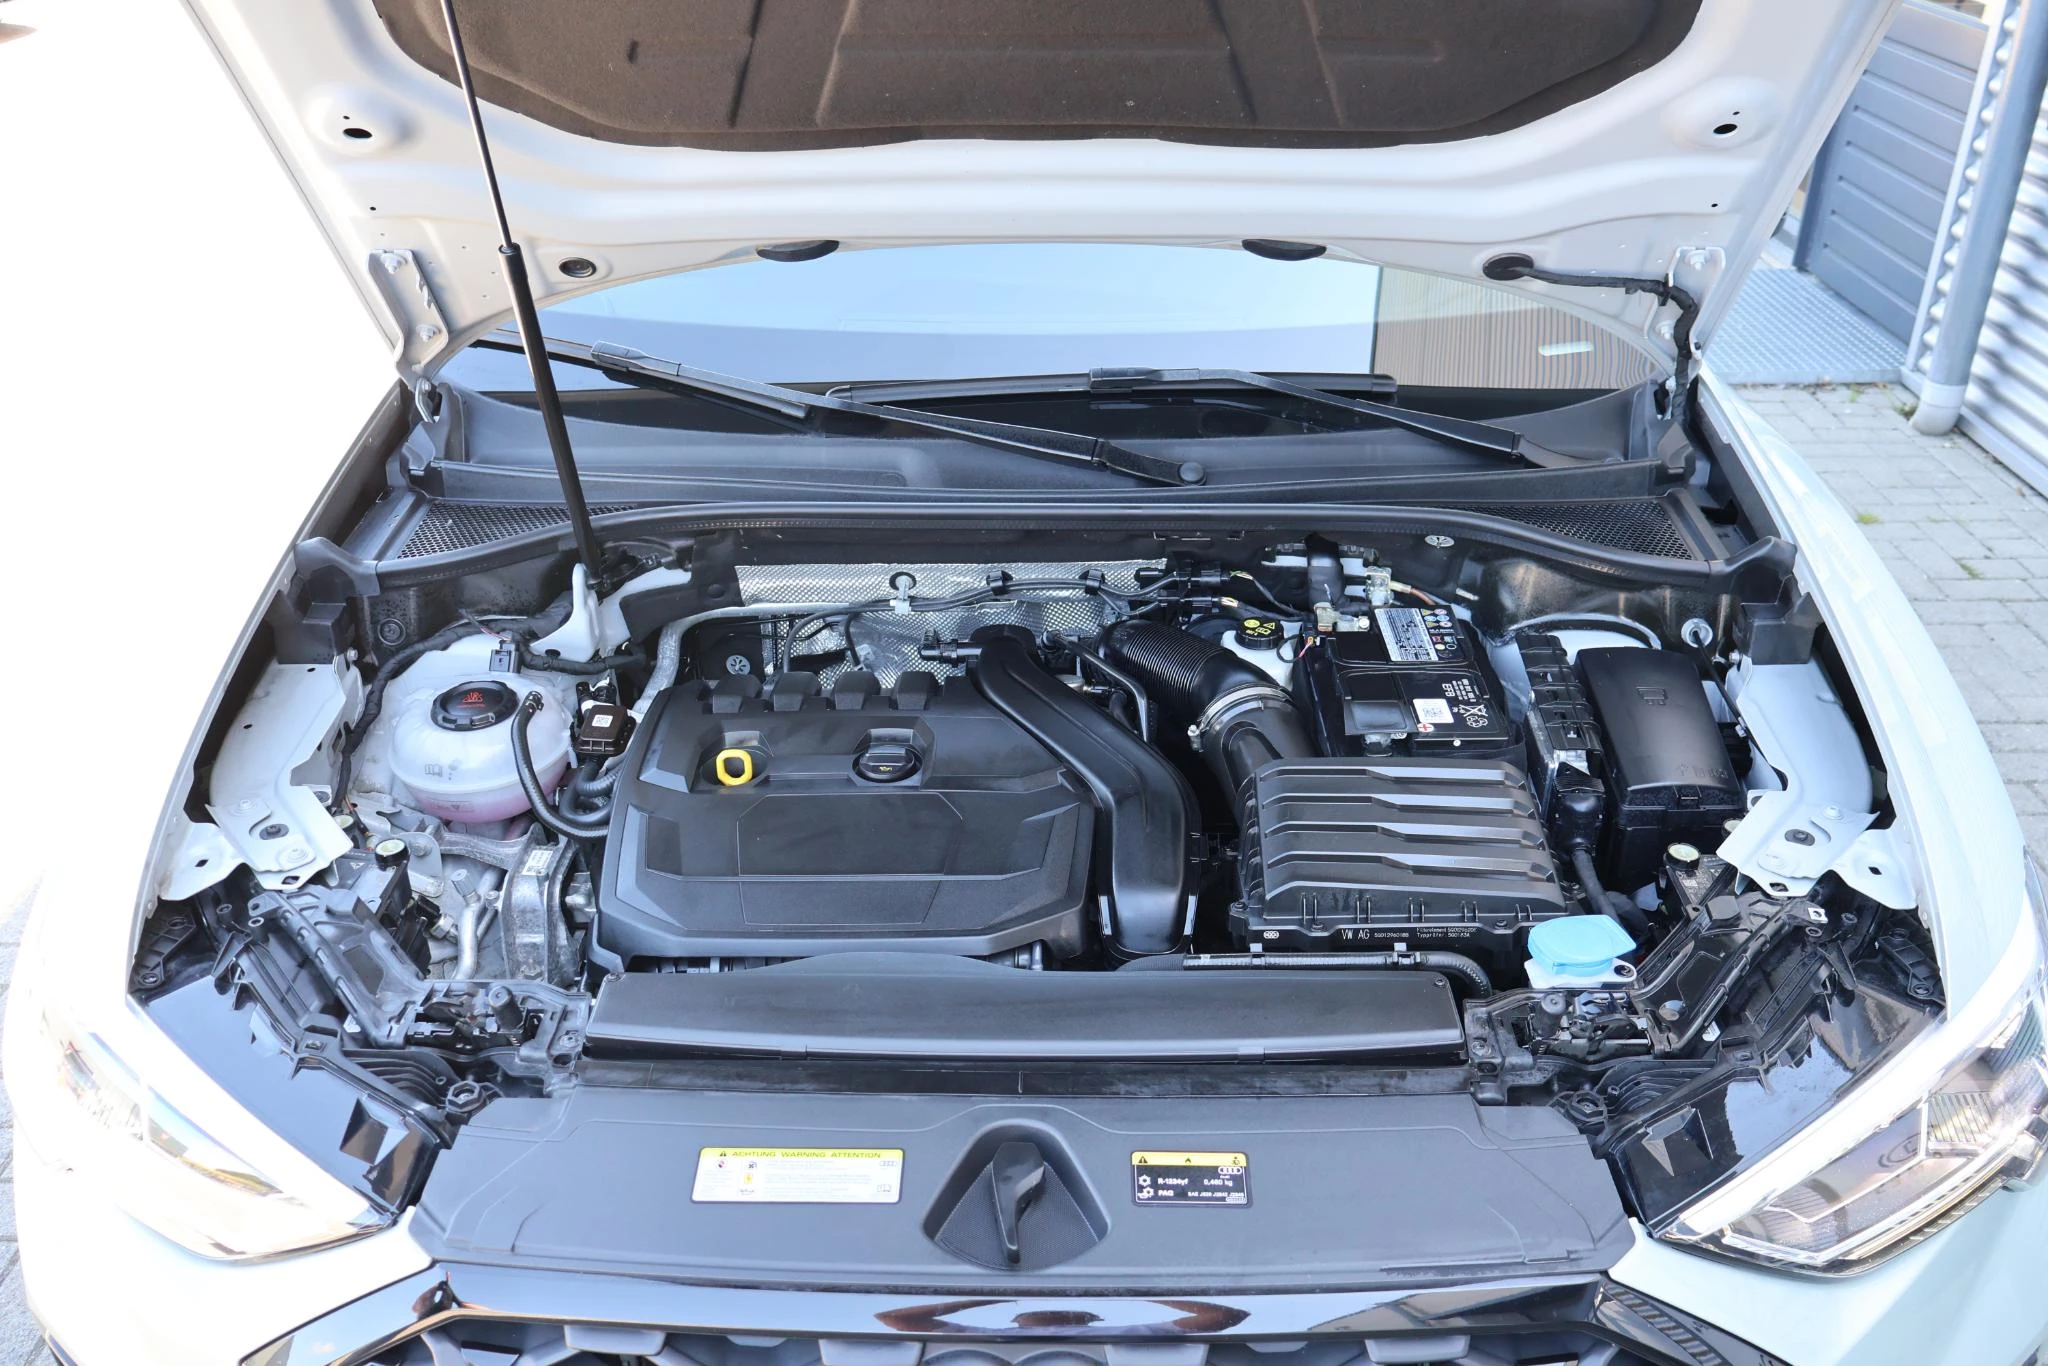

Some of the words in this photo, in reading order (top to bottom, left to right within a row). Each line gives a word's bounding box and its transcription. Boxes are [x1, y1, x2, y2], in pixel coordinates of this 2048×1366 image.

[1442, 683, 1456, 697] EFB
[1341, 928, 1354, 940] VW
[1357, 928, 1370, 940] AG
[1157, 1178, 1189, 1186] R-1234yf
[1224, 1179, 1233, 1187] kg
